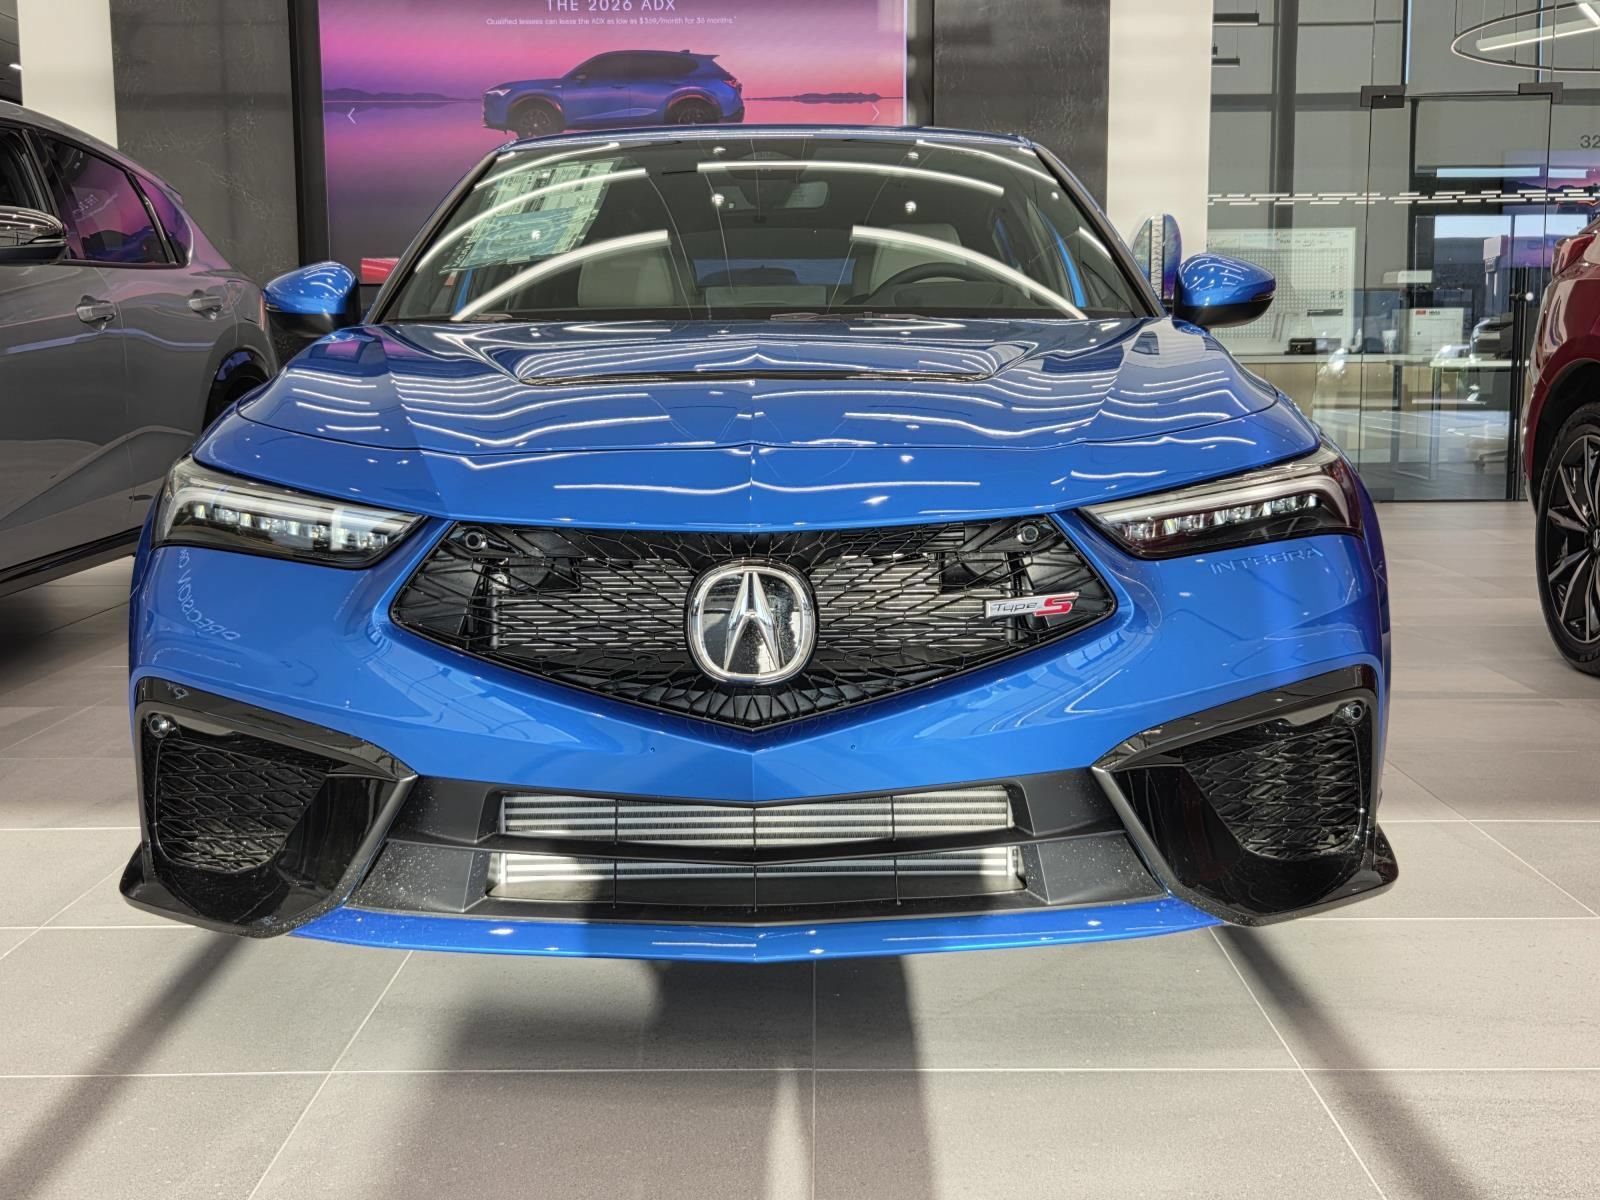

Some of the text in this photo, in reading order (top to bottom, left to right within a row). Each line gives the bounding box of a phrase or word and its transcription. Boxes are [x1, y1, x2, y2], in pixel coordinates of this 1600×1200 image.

[545, 0, 676, 11] THE 2026 ADX
[1210, 548, 1324, 575] INTEGRA
[991, 592, 1079, 617] Type S
